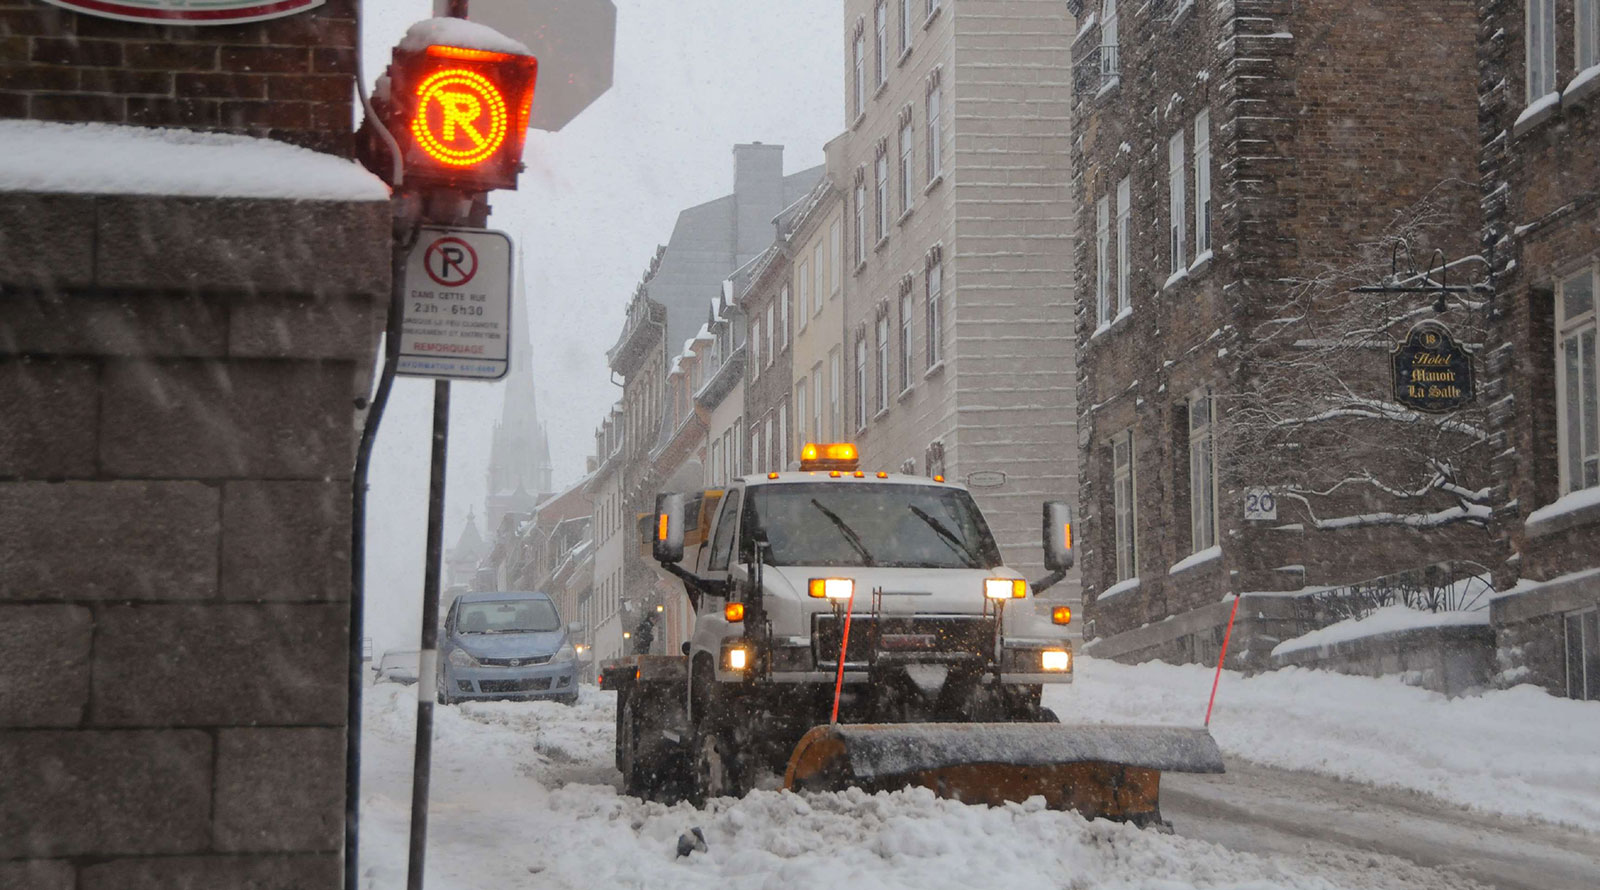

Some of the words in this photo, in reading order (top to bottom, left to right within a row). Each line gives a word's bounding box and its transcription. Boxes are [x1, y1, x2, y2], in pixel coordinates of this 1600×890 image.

[438, 292, 465, 301] CETTE
[470, 293, 487, 302] RUE
[414, 302, 438, 313] 23h
[451, 304, 483, 316] 6h30
[1426, 333, 1436, 344] 18
[414, 341, 485, 354] REMORQUAGE
[1411, 368, 1456, 382] Manoir
[1408, 385, 1424, 398] La
[1428, 385, 1461, 398] Salle
[1247, 494, 1275, 512] 20
